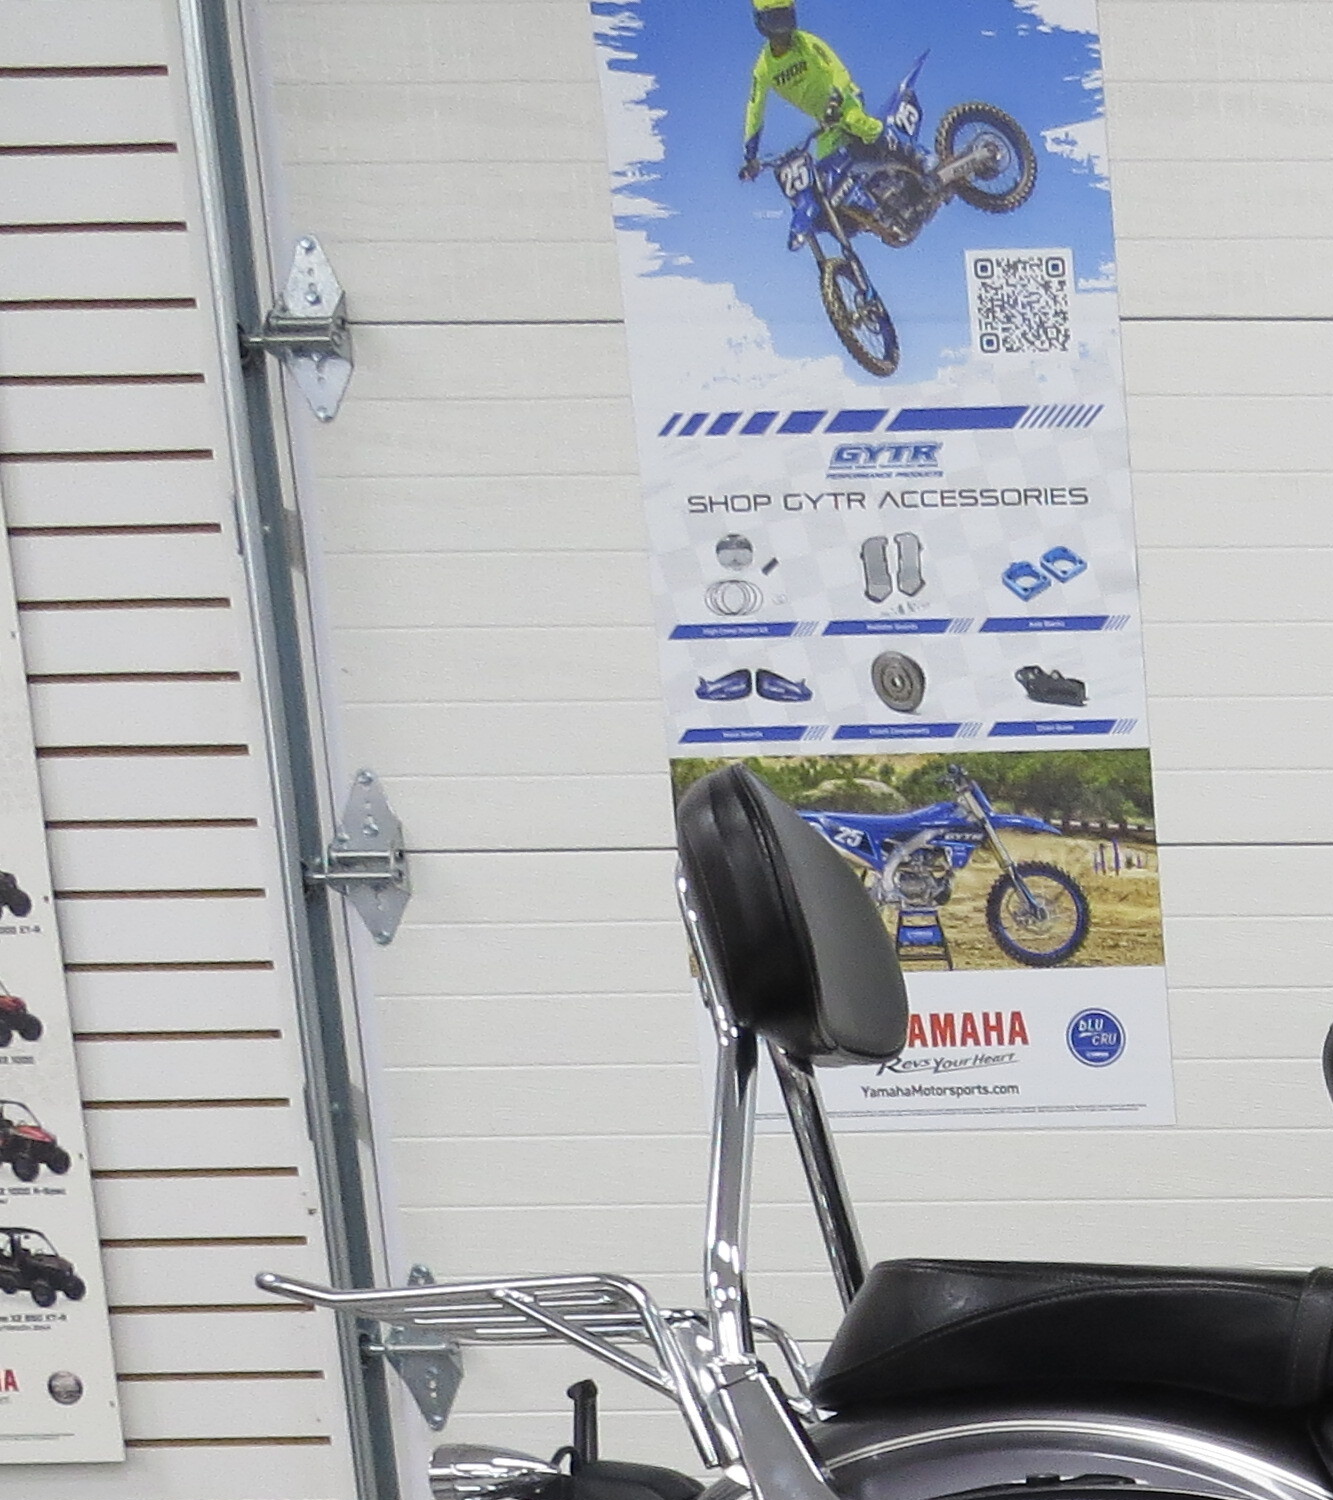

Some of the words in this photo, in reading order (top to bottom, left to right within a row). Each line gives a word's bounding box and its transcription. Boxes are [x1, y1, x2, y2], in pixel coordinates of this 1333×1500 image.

[780, 156, 810, 197] 25
[831, 441, 943, 467] GYTR
[826, 472, 892, 480] PERFORMANCE
[688, 494, 772, 514] SHOP
[783, 491, 866, 512] GYTR
[878, 487, 1089, 510] ACCESSORIES
[833, 826, 865, 848] 25
[908, 1011, 1029, 1048] AMAHA
[876, 1056, 932, 1076] Revs
[932, 1055, 971, 1075] Your
[972, 1051, 1017, 1068] Heart
[861, 1084, 1020, 1099] YamahaMotorsports.com
